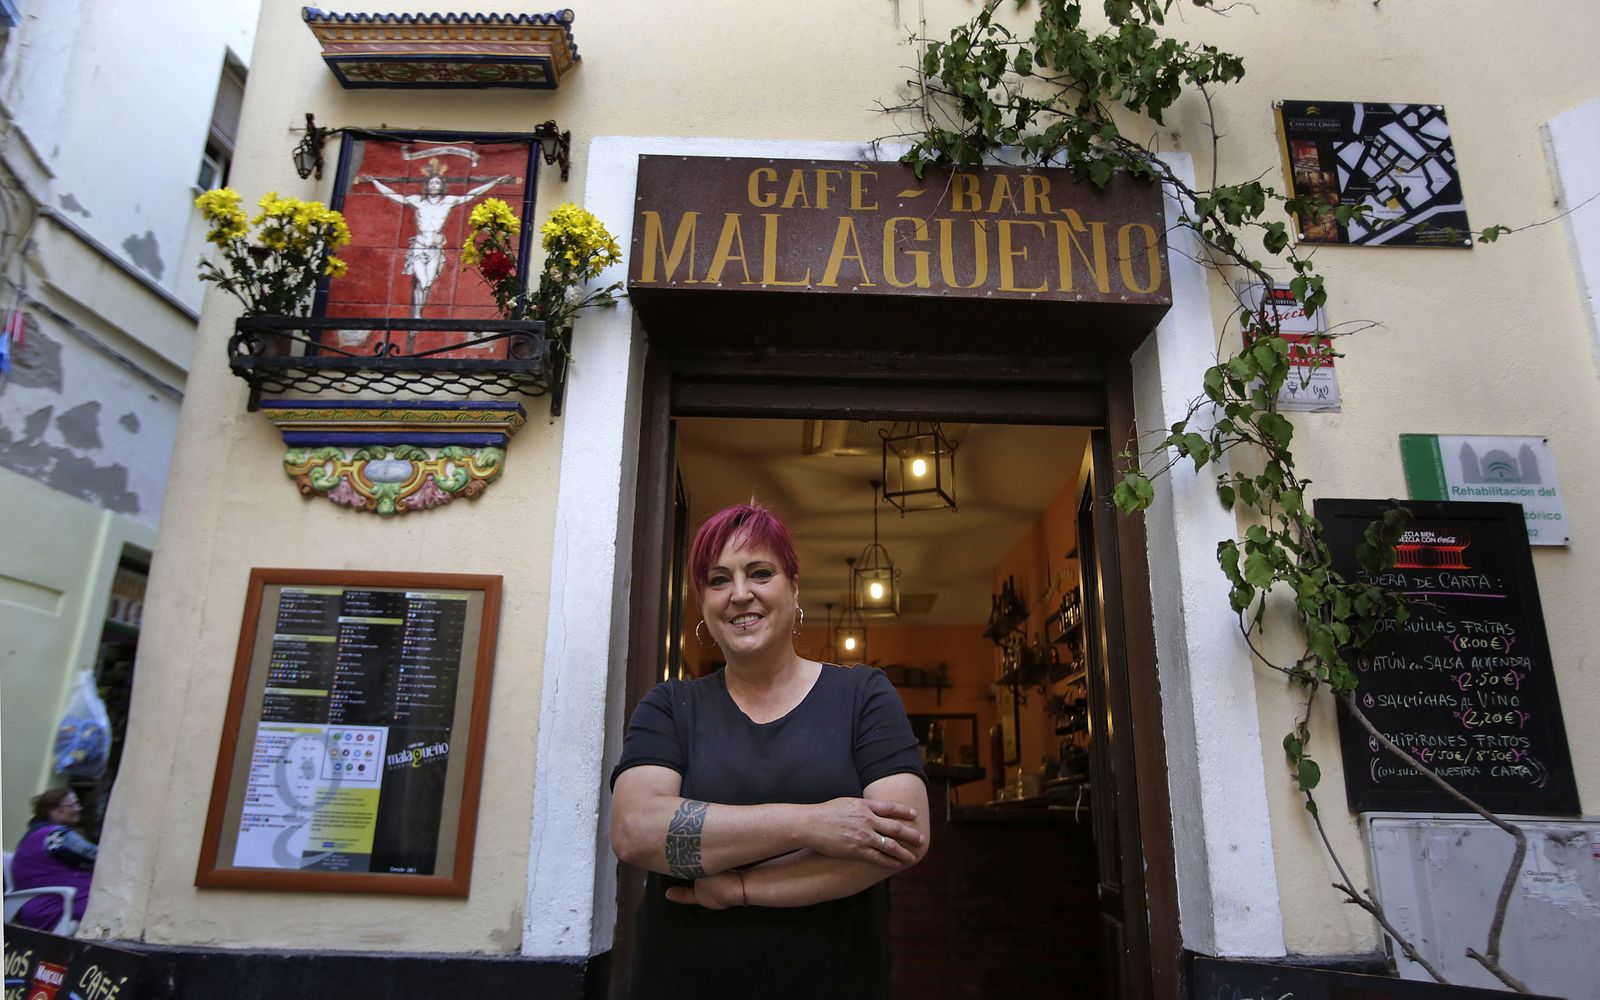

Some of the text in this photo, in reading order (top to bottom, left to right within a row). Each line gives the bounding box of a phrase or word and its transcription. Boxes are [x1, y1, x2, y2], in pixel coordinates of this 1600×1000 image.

[950, 173, 1058, 215] BAR
[637, 208, 1161, 294] MALAGUEÑO
[1451, 486, 1556, 497] Rehabilitación del
[1525, 510, 1562, 521] tórico
[1412, 577, 1436, 589] DE
[1373, 652, 1406, 671] ATÚN
[1423, 655, 1464, 670] SALSA
[1471, 656, 1532, 671] ALMENDRA
[1461, 697, 1474, 711] AL
